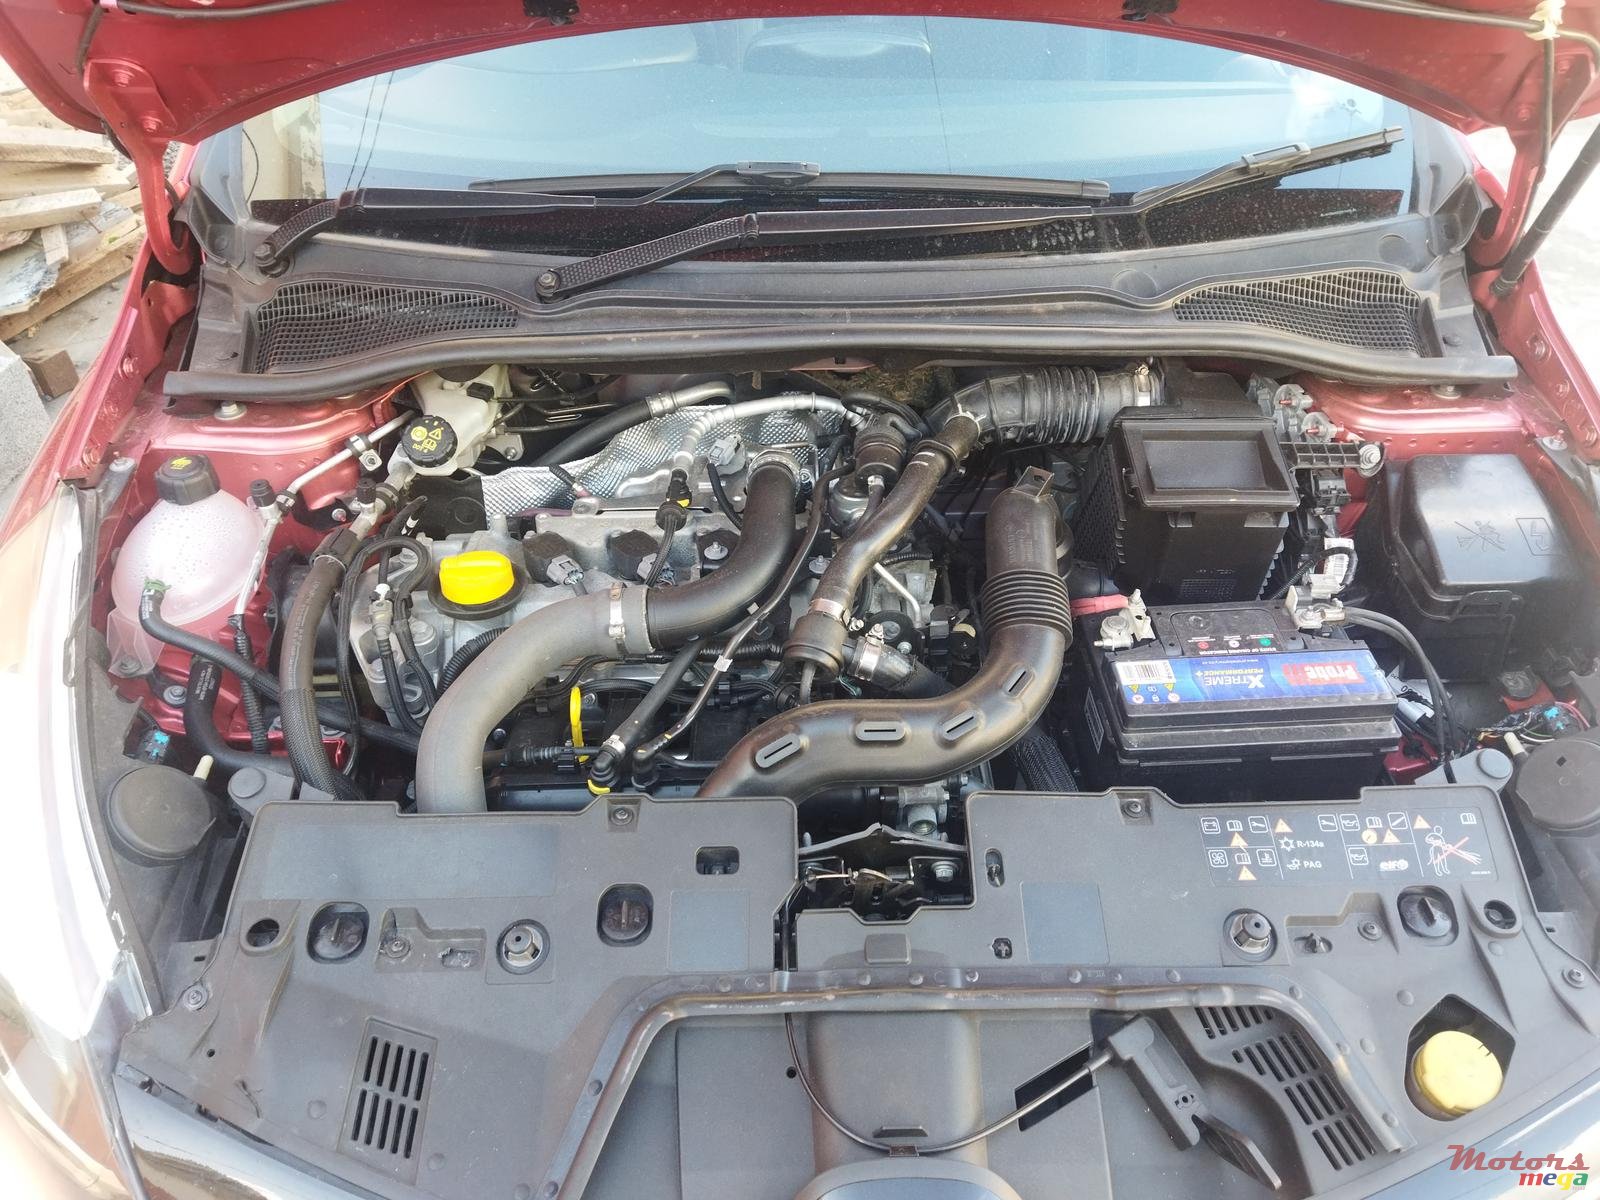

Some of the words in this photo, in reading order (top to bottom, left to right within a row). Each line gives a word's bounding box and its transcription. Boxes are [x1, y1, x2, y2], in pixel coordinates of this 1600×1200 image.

[1303, 664, 1359, 681] Probe
[1204, 674, 1265, 689] XTREME
[1296, 840, 1325, 848] R-134a
[1303, 860, 1322, 869] PAG
